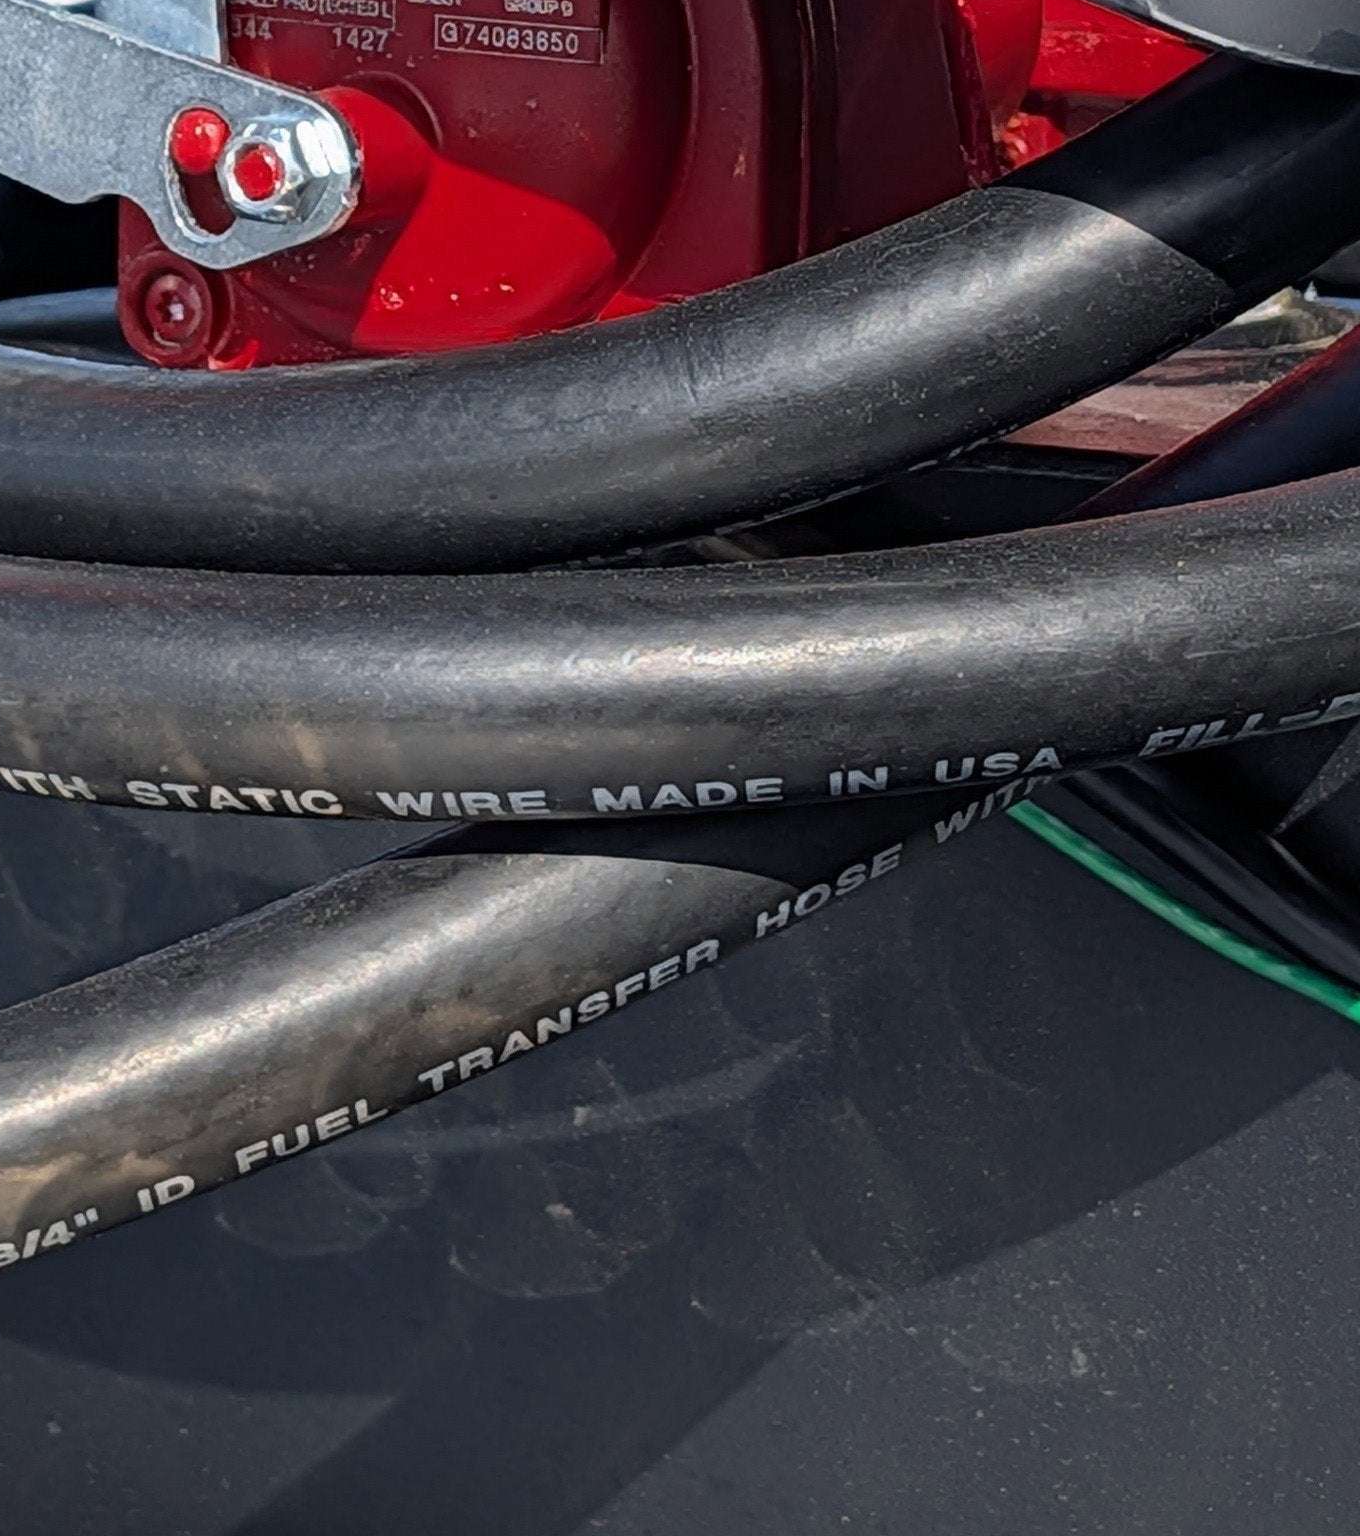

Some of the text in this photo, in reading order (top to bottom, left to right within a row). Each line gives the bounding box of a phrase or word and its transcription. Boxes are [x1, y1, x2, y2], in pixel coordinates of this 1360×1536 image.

[332, 27, 389, 52] 1427
[126, 779, 344, 817] STATIC
[376, 789, 551, 818] WIRE
[591, 777, 785, 814] MADE
[829, 767, 888, 797] IN
[935, 747, 1062, 783] USA
[136, 1173, 196, 1214] ID
[235, 1098, 390, 1175] FUEL
[418, 938, 720, 1095] TRANSFER
[755, 842, 904, 939] HOSE
